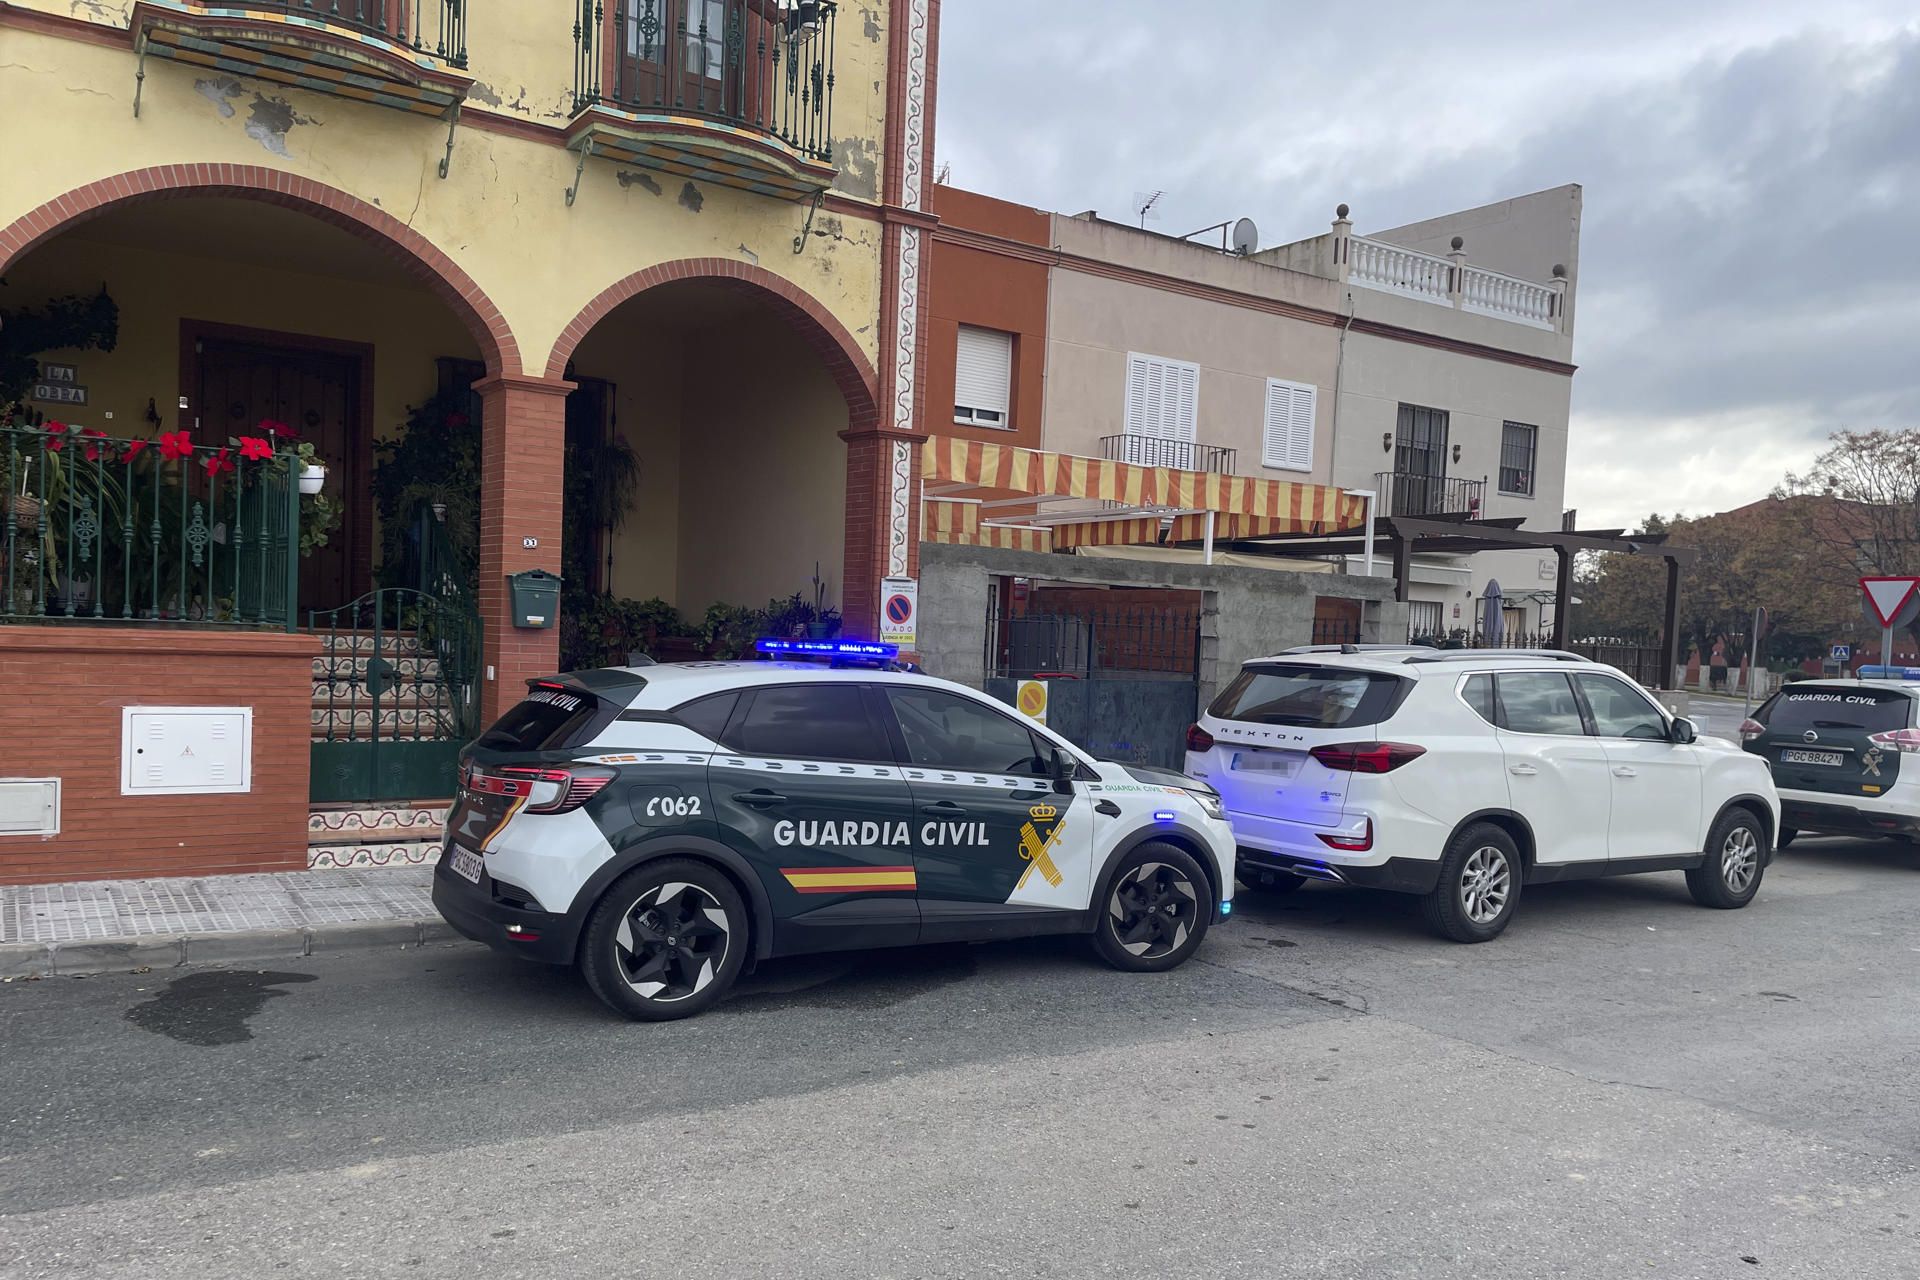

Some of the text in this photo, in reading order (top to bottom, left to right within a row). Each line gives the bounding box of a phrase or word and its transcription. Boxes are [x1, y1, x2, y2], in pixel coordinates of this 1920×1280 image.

[550, 694, 581, 711] CIVIL
[1789, 694, 1877, 706] GUARDIA CIVIL
[1220, 727, 1304, 741] REXTON
[773, 820, 990, 846] GUARDIA CIVIL
